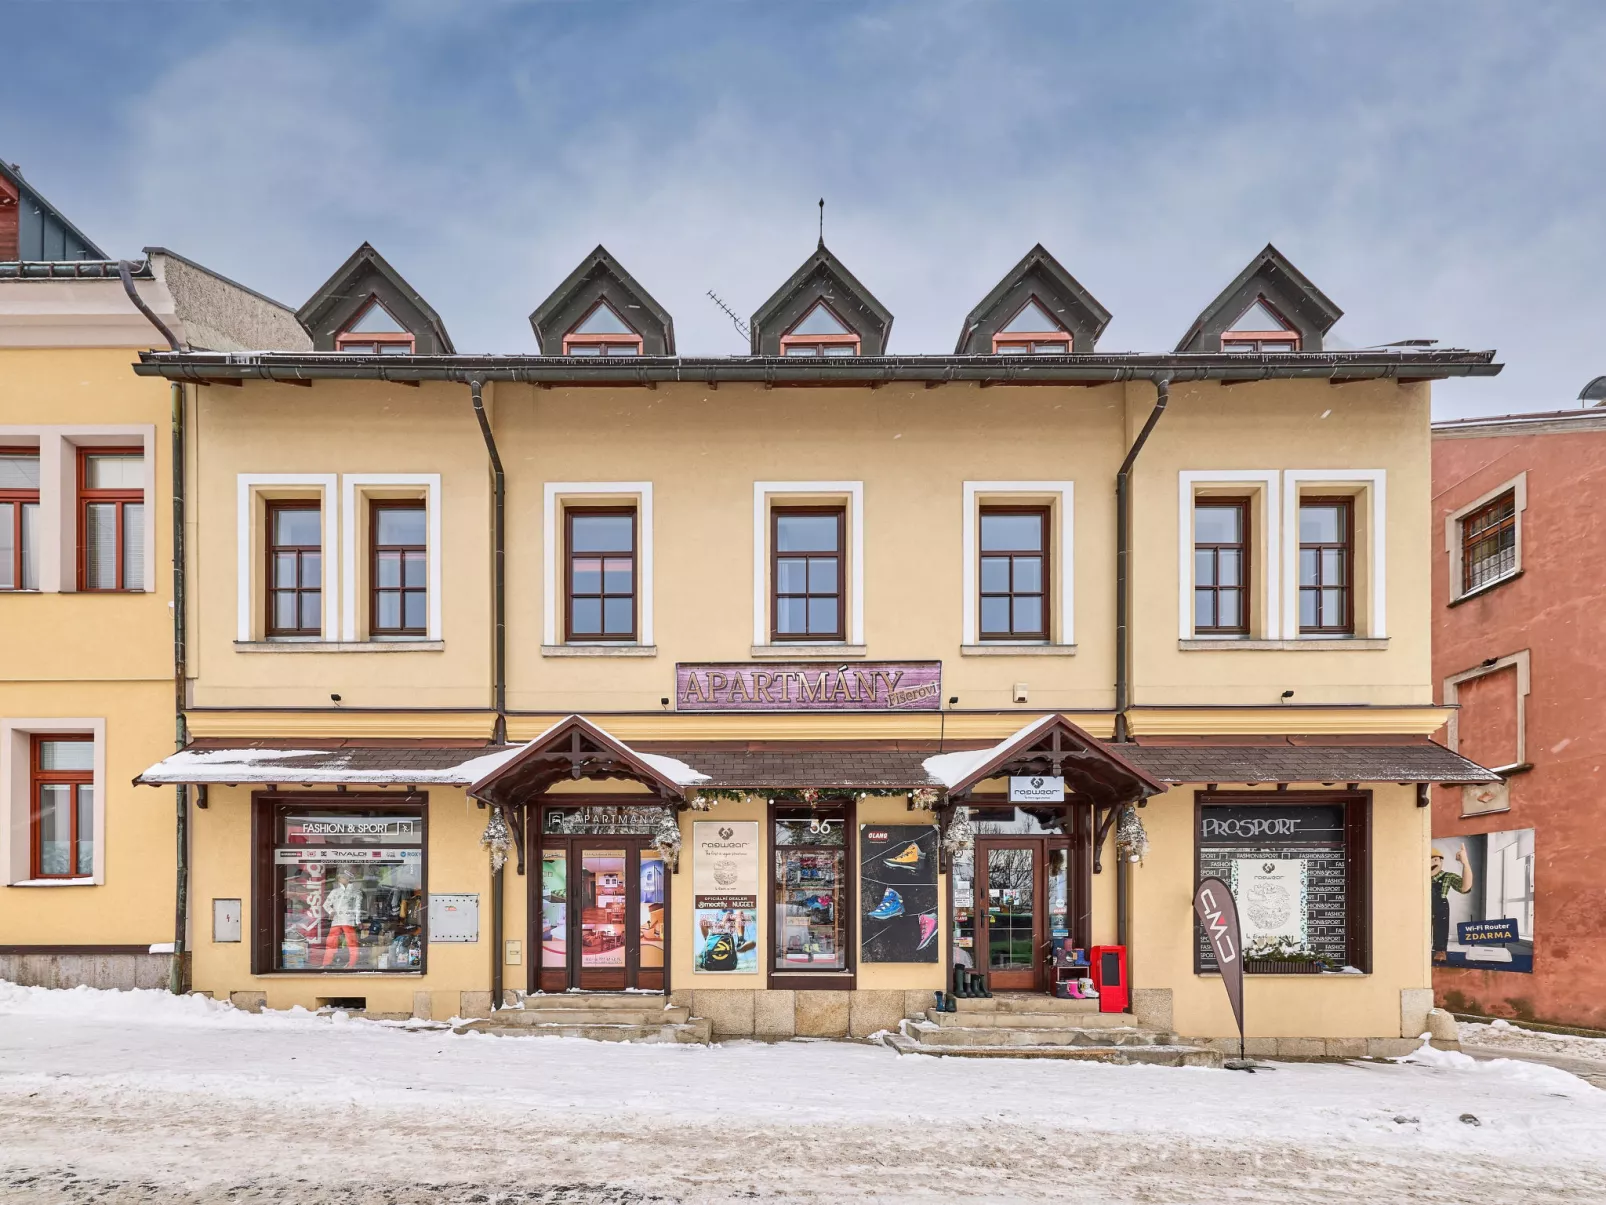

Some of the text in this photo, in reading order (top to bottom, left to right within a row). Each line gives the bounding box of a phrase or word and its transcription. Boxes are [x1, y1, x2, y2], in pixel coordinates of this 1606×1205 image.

[681, 664, 905, 703] APARTMÁNY
[302, 823, 389, 833] FASHION & SPORT
[810, 818, 831, 834] 56
[1202, 818, 1301, 837] PROSPORT
[1465, 932, 1511, 940] ZDARMA
